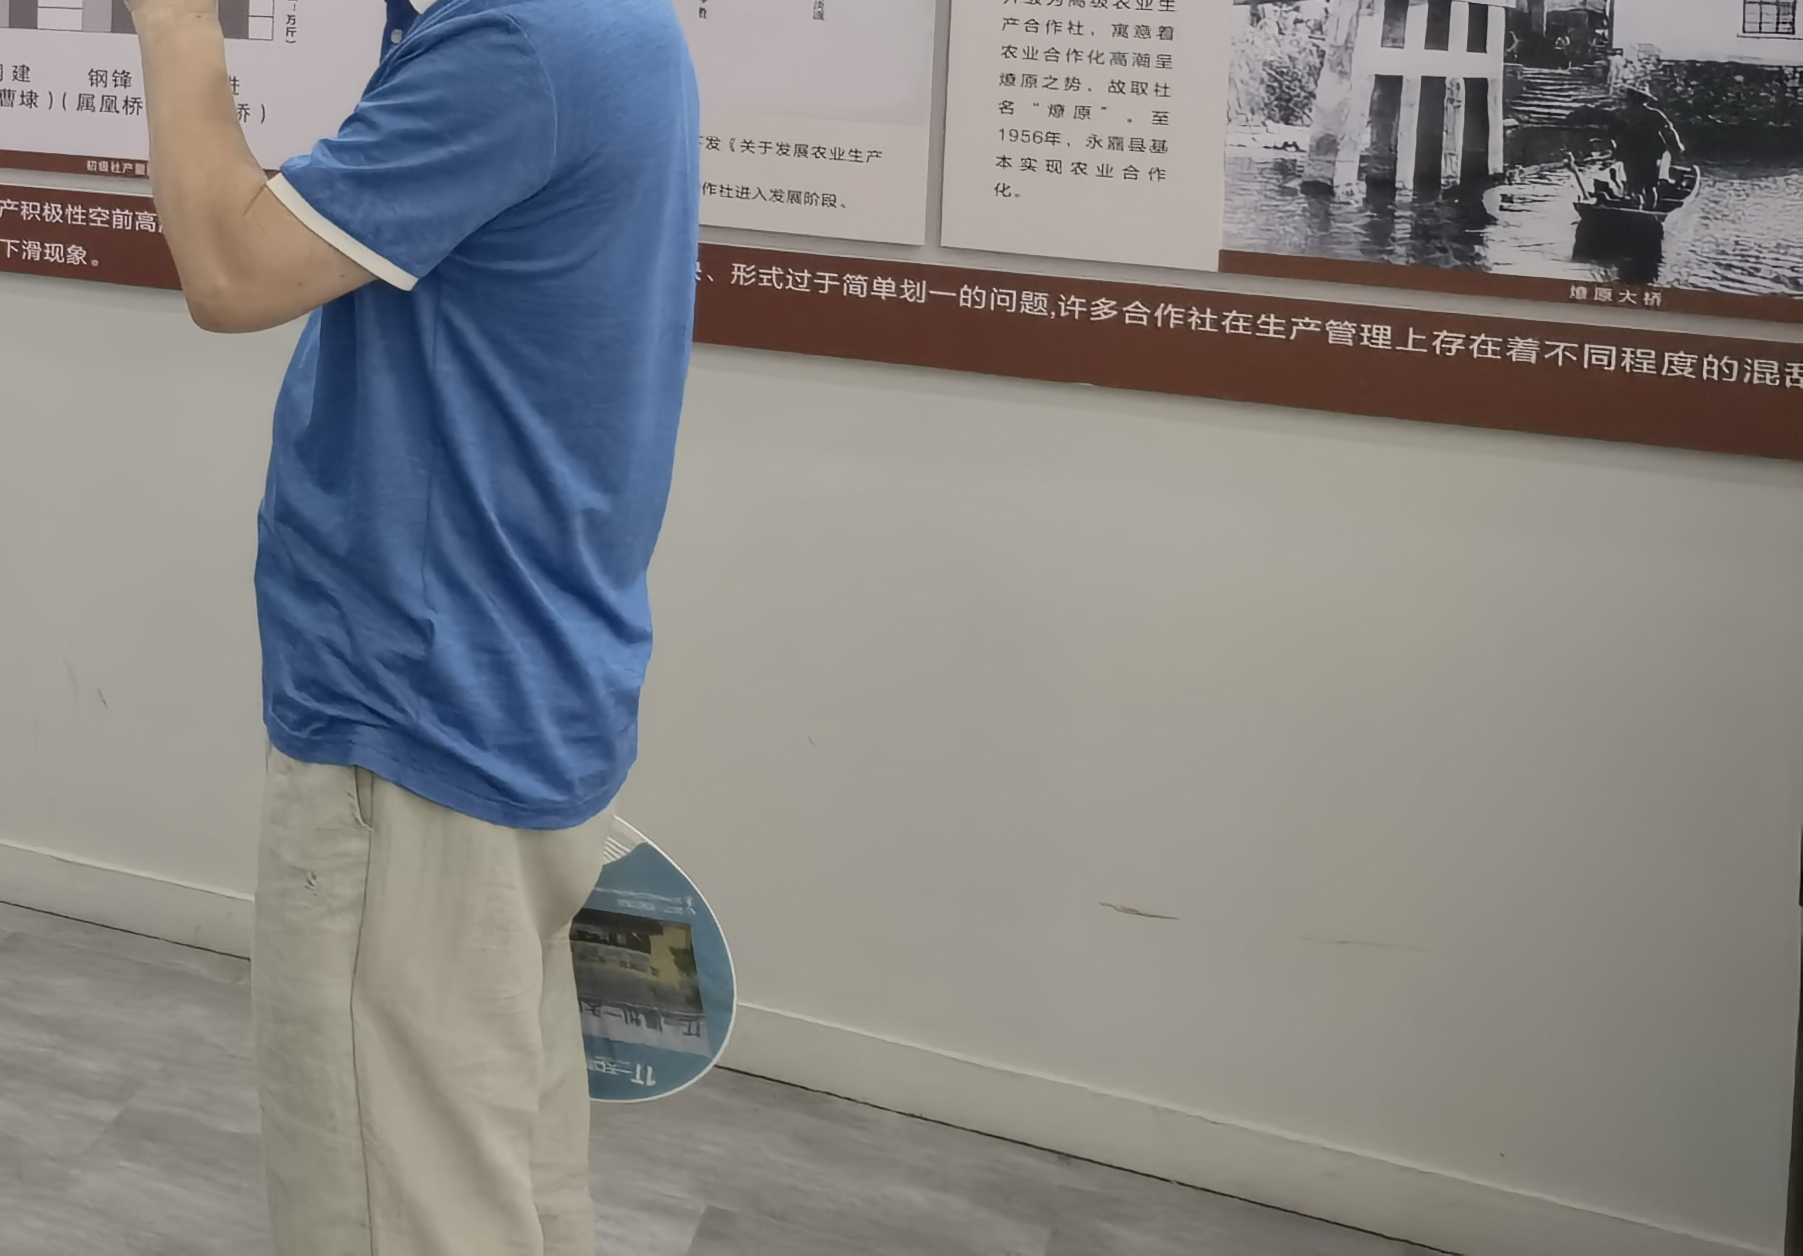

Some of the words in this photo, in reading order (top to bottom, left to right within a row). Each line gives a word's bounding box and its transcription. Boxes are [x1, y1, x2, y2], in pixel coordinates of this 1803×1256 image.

[699, 135, 883, 164] 发《关于发展农业生产
[995, 155, 1166, 182] 本实现农业合作
